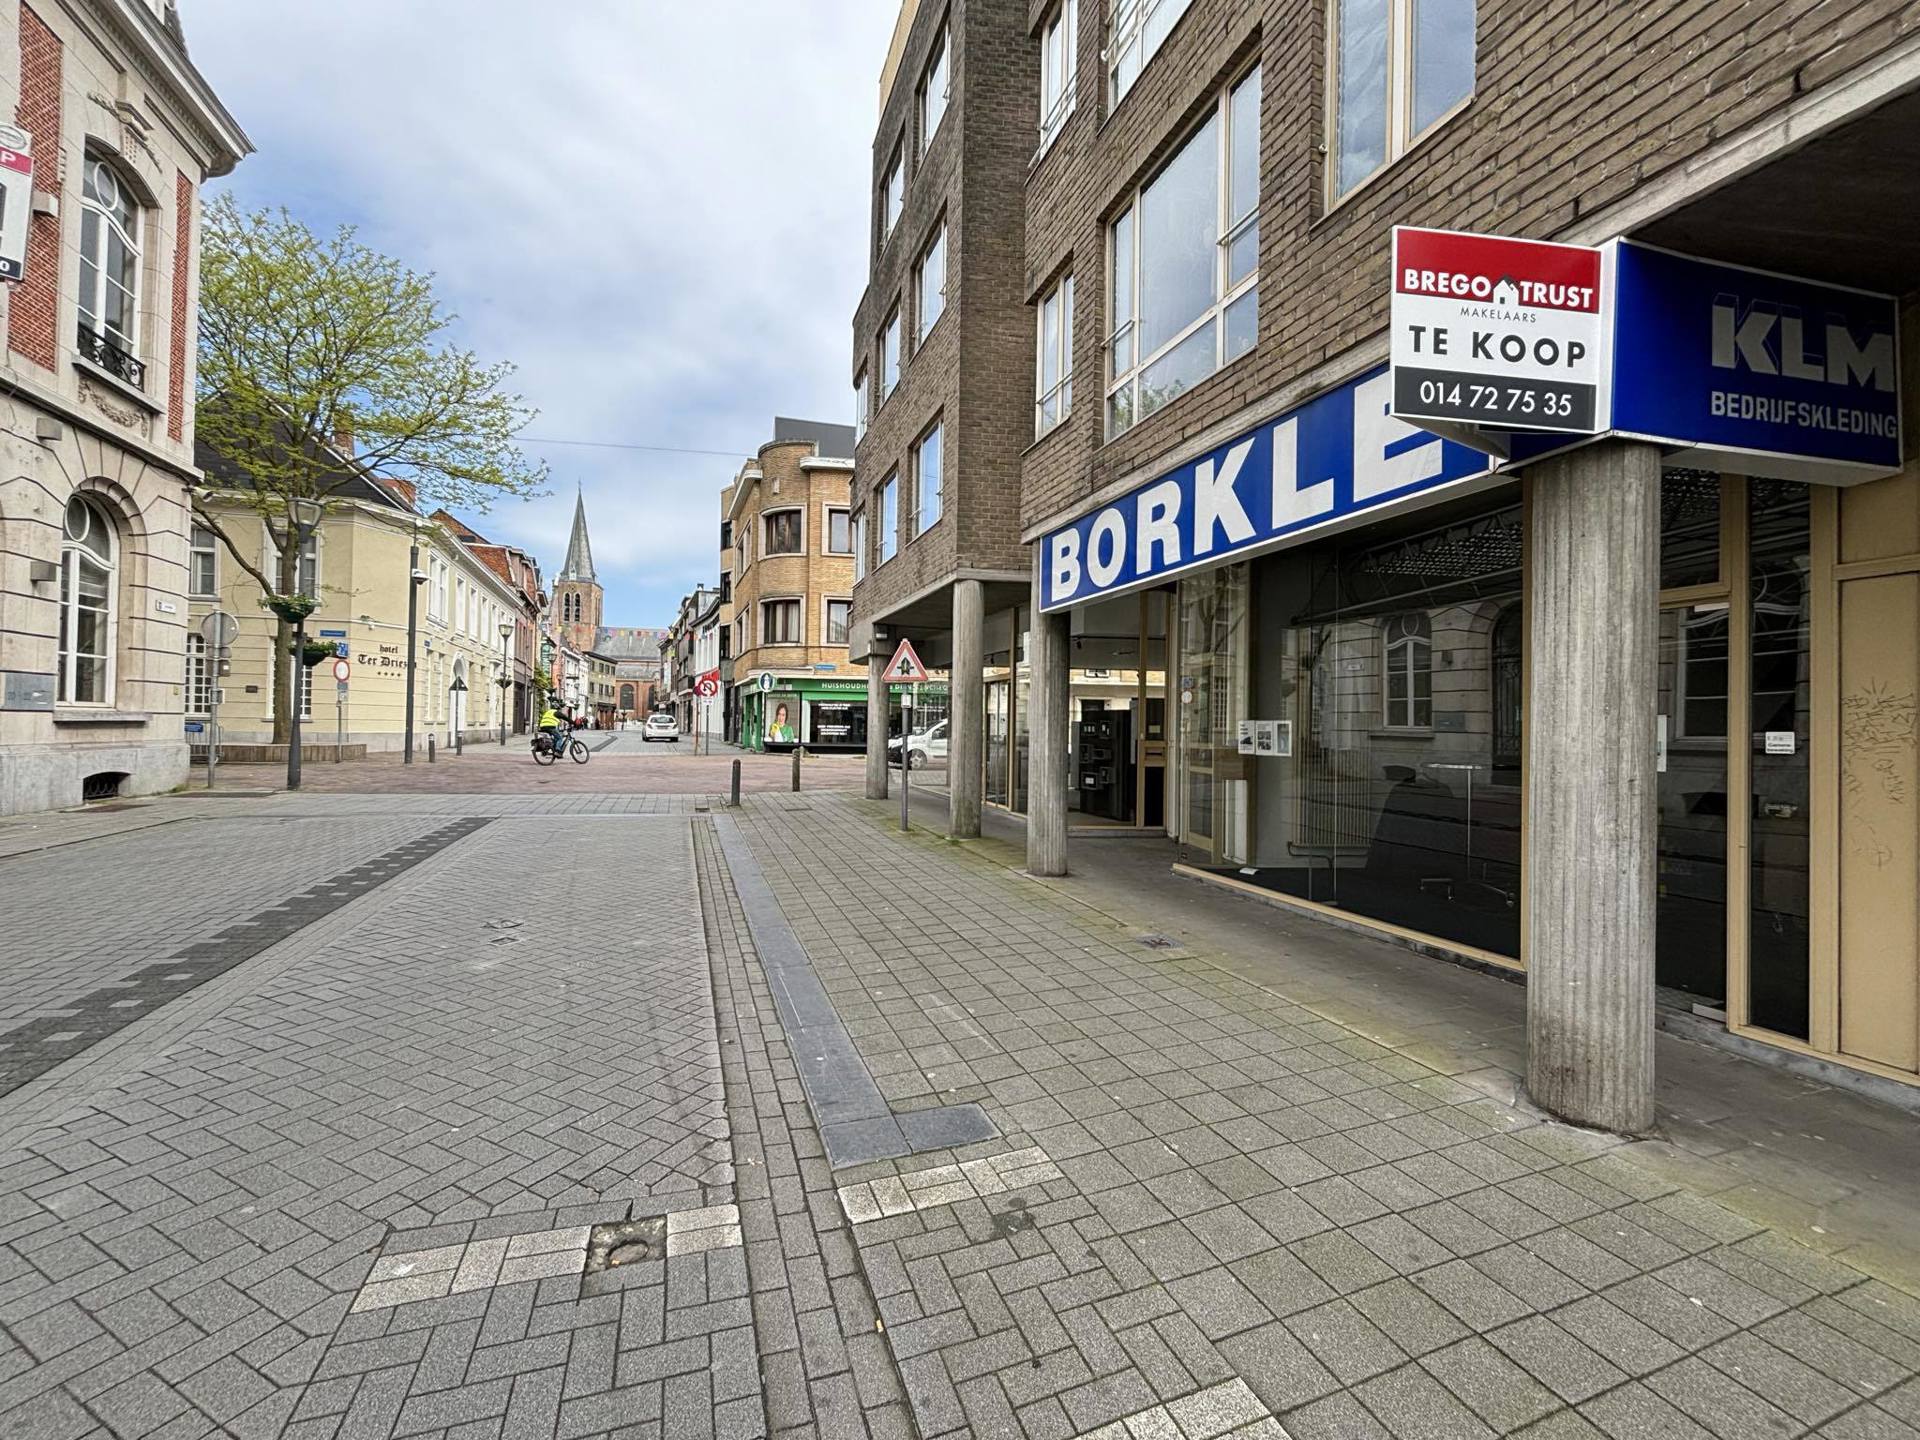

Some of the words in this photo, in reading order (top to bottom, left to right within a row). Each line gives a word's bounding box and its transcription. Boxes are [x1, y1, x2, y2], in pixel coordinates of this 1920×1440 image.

[1404, 268, 1492, 297] BREGO
[1519, 280, 1594, 309] TRUST
[1460, 307, 1537, 323] MAKELAARS
[1409, 325, 1448, 356] TE
[1472, 331, 1586, 368] KOOP
[1711, 304, 1896, 393] KLM
[1420, 380, 1462, 406] 014
[1470, 385, 1499, 410] 72
[1507, 389, 1536, 413] 75
[1543, 392, 1573, 416] 35
[1711, 390, 1898, 438] BEDRIJFSKLEDING
[358, 654, 377, 665] Ter
[379, 644, 399, 654] hotel
